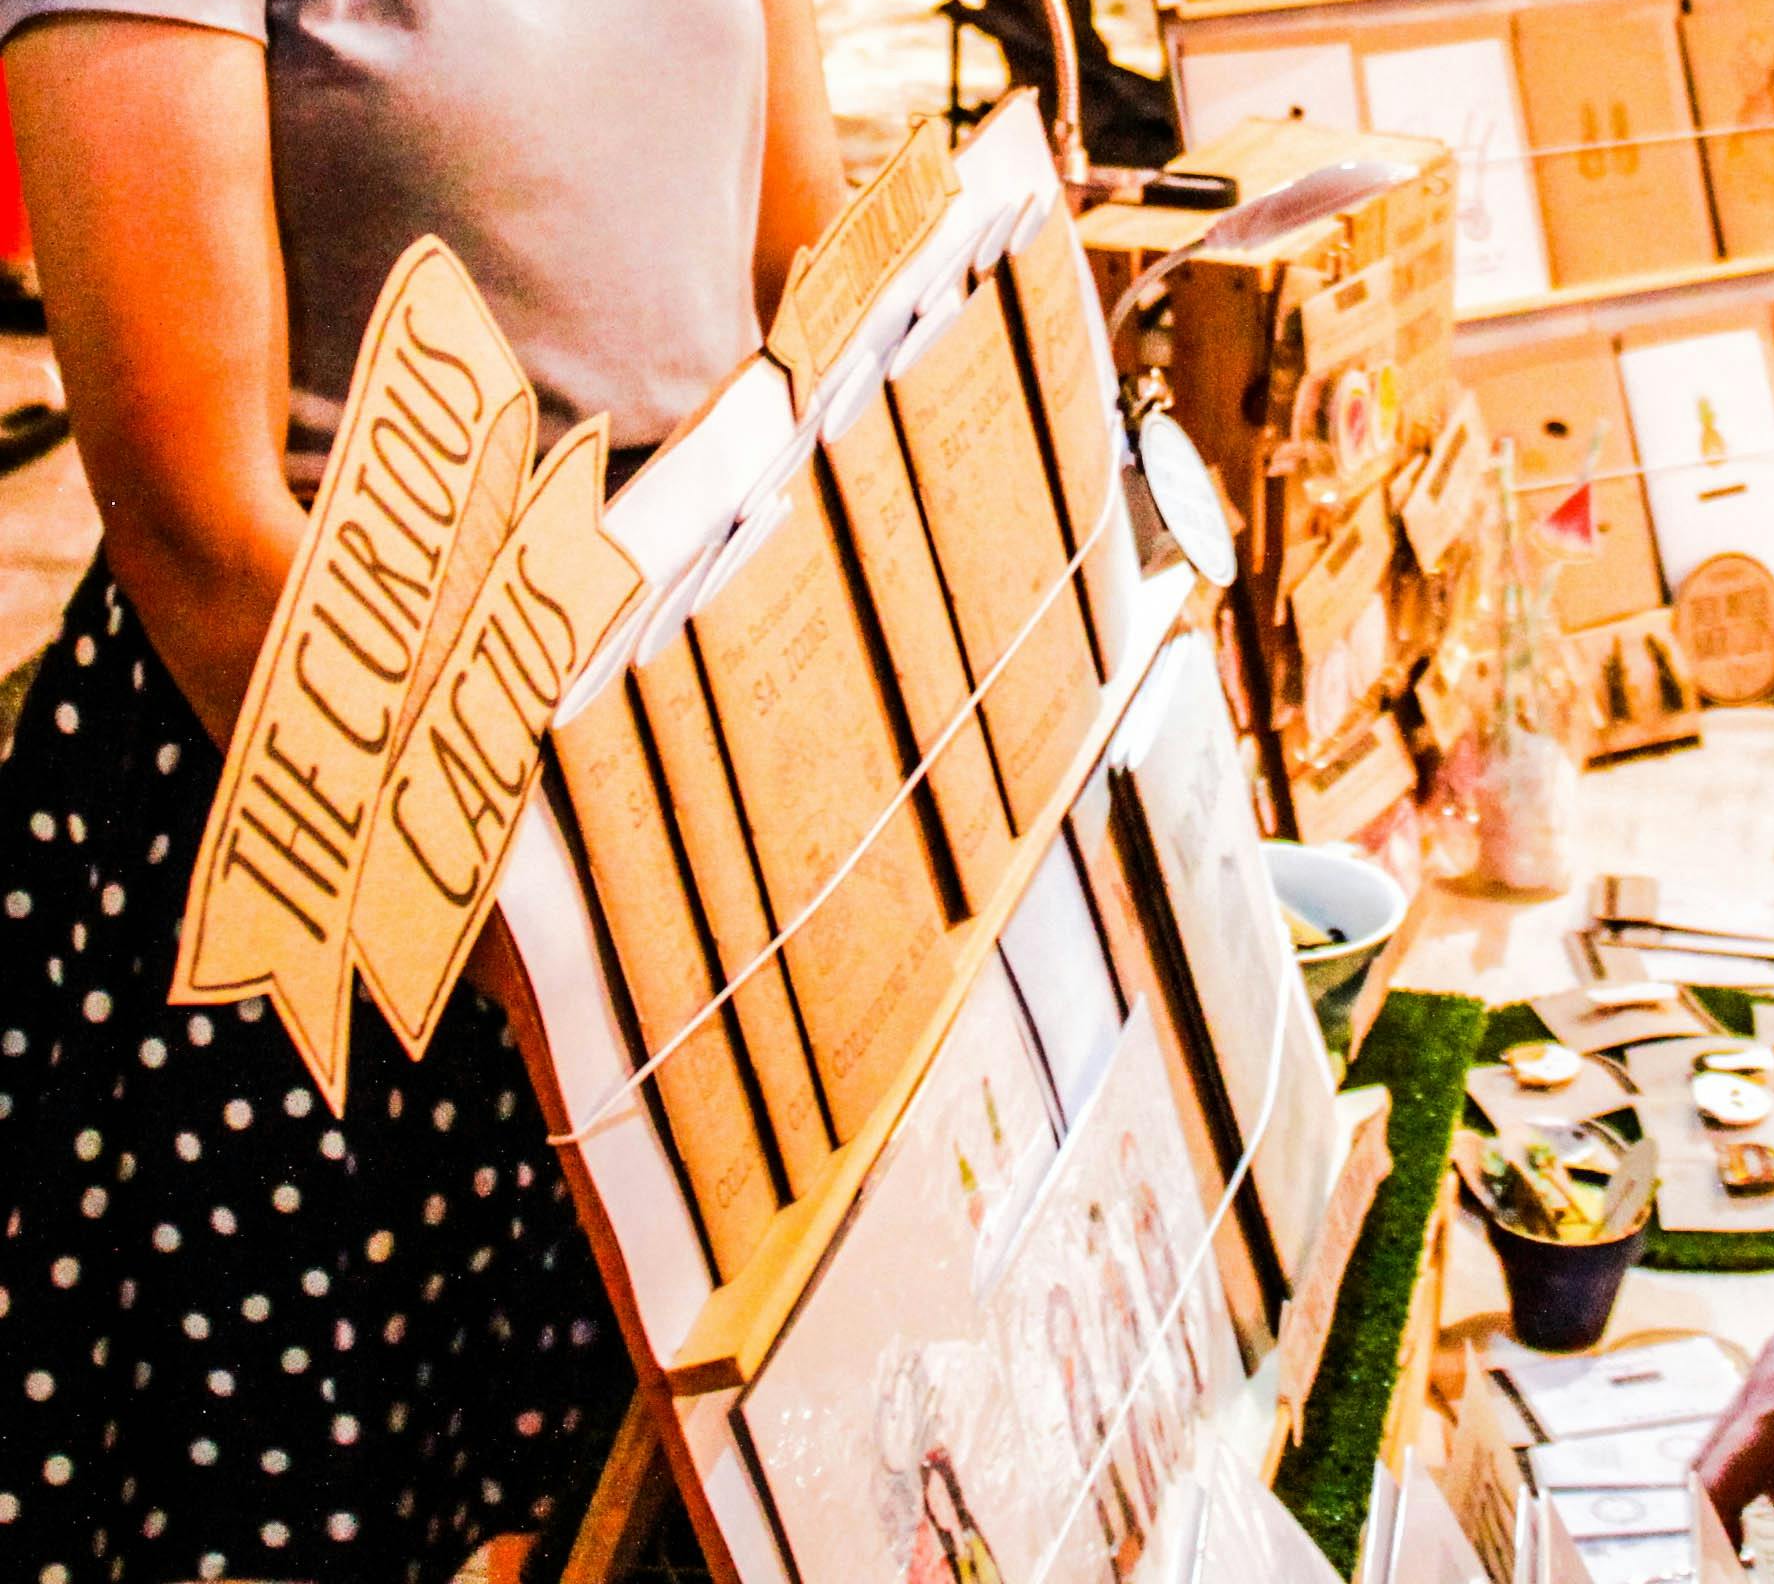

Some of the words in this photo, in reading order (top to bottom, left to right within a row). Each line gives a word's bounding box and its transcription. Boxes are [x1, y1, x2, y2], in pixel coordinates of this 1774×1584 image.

[222, 722, 365, 945] THE
[294, 305, 488, 758] CURIOUS
[395, 542, 579, 909] CACTUS
